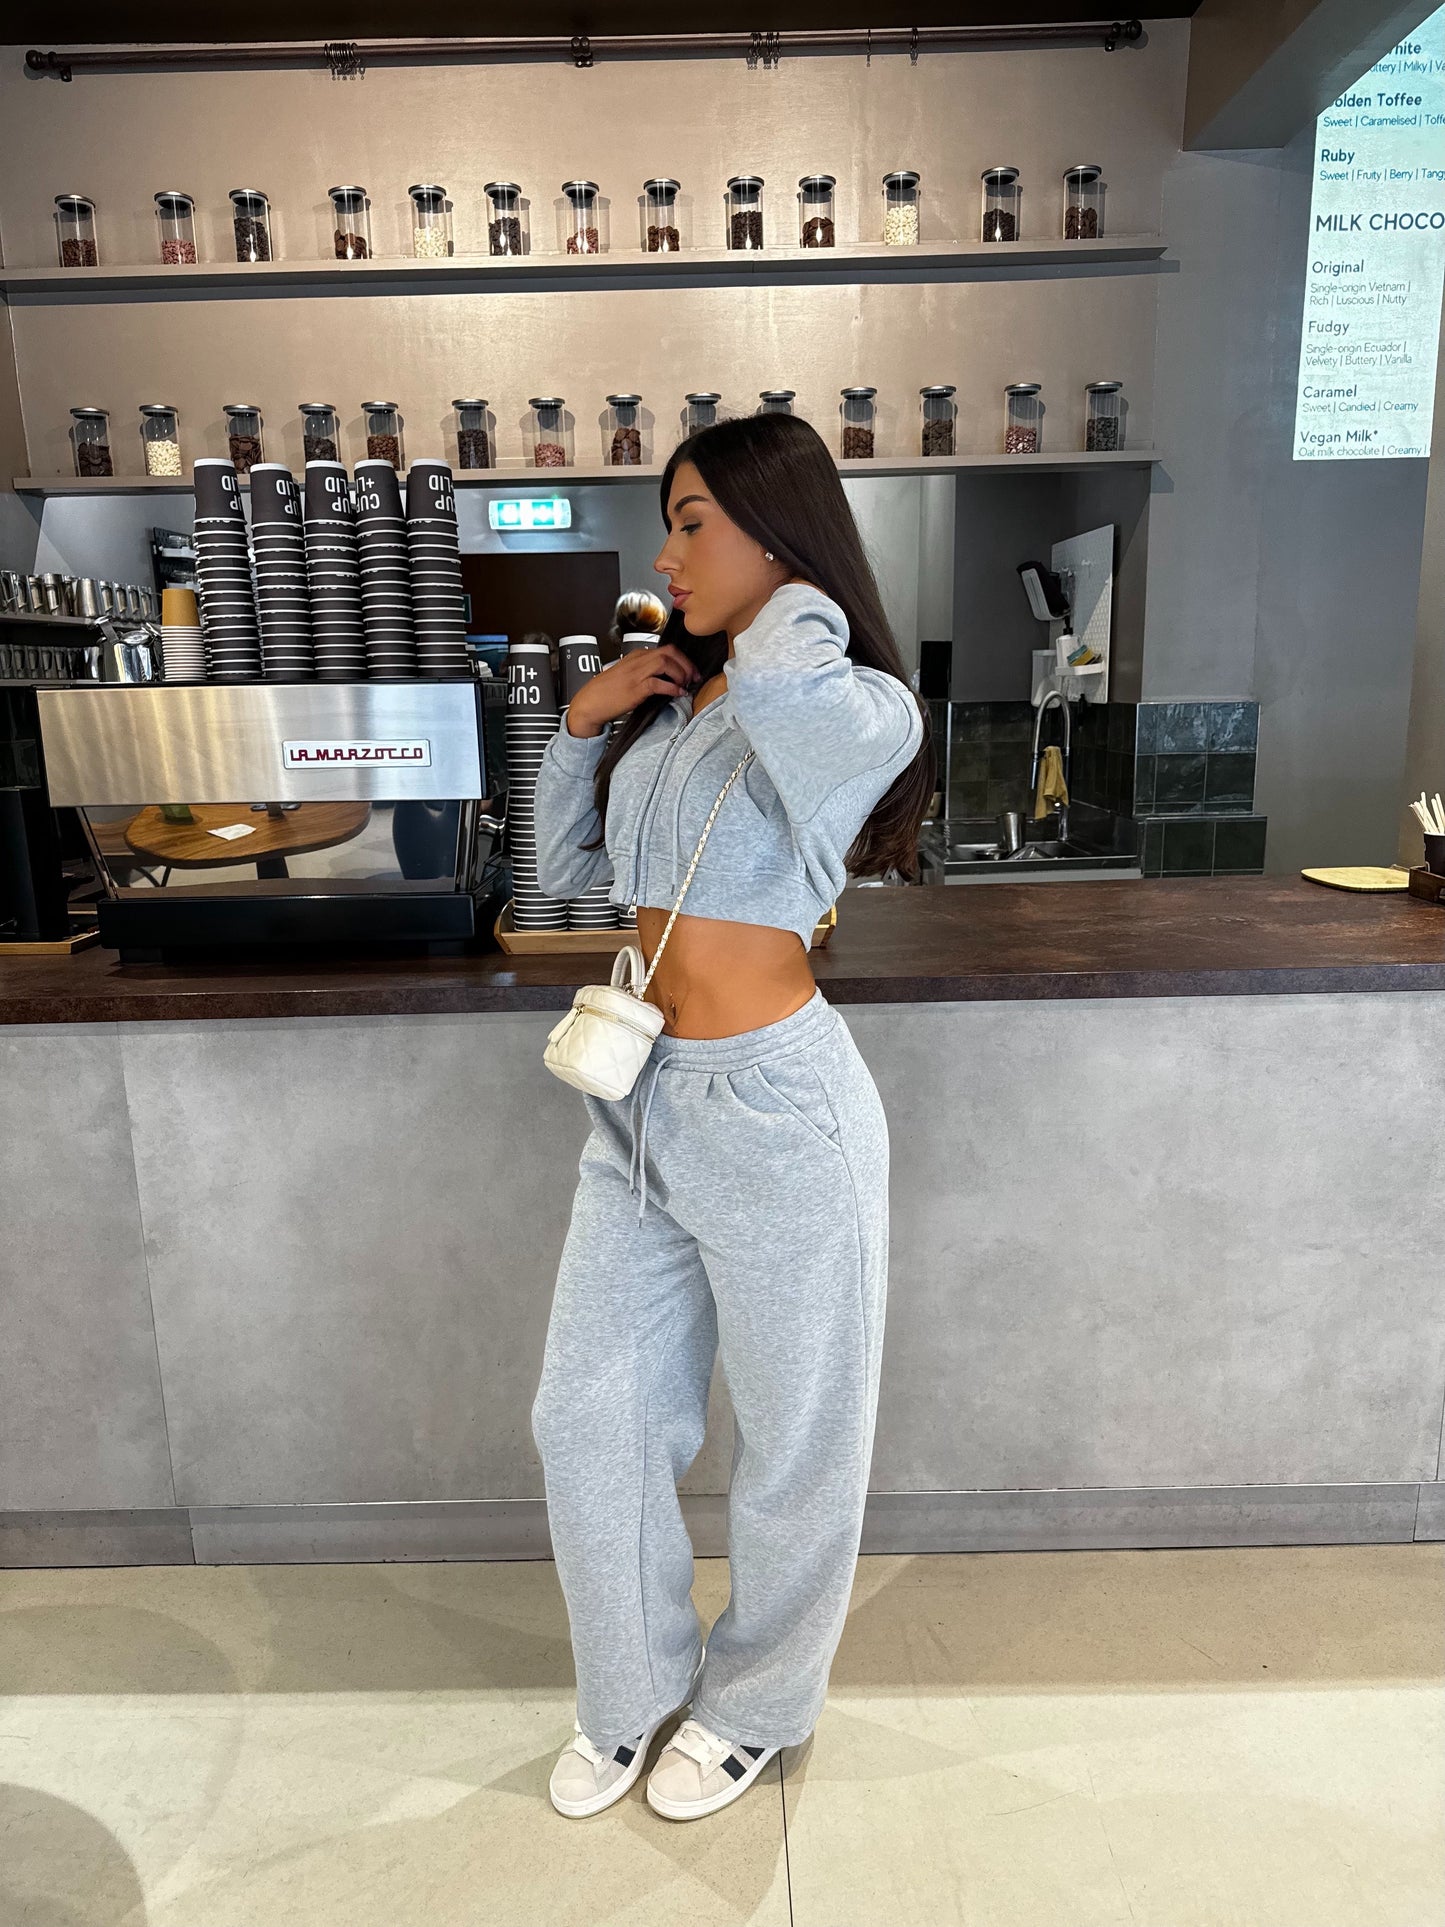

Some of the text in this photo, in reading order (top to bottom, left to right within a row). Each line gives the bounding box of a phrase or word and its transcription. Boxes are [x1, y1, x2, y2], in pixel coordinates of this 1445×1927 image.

[1388, 41, 1422, 55] hite
[1370, 63, 1397, 75] uttery
[1403, 61, 1428, 74] Milky
[1334, 92, 1423, 107] olden Toffee
[1323, 116, 1353, 127] Sweet
[1361, 115, 1417, 127] Caramelised
[1321, 149, 1355, 165] Ruby
[1320, 170, 1349, 181] Sweet
[1356, 169, 1382, 182] Fruity
[1389, 168, 1414, 181] Berry
[1316, 211, 1445, 232] MILK CHOCO
[1312, 259, 1365, 277] Original
[1310, 281, 1406, 295] Single-origin Vietnam
[1309, 294, 1408, 306] Rich Luscious Nutty
[1308, 320, 1350, 336] Fudgy
[1306, 342, 1402, 356] Single-origin Ecuador
[1305, 354, 1413, 368] Velvety Buttery Vanilla
[1303, 384, 1358, 398] Caramel
[1302, 400, 1419, 413] Sweet Candied Creamy
[1300, 431, 1341, 446] Vegan
[1298, 445, 1422, 457] Oat milk chocolate Creamy
[276, 479, 297, 497] LID
[325, 476, 348, 494] LID
[284, 499, 298, 516] UP
[331, 496, 351, 514] UP
[435, 494, 455, 512] UP
[578, 655, 602, 672] LID
[508, 685, 540, 705] CUP
